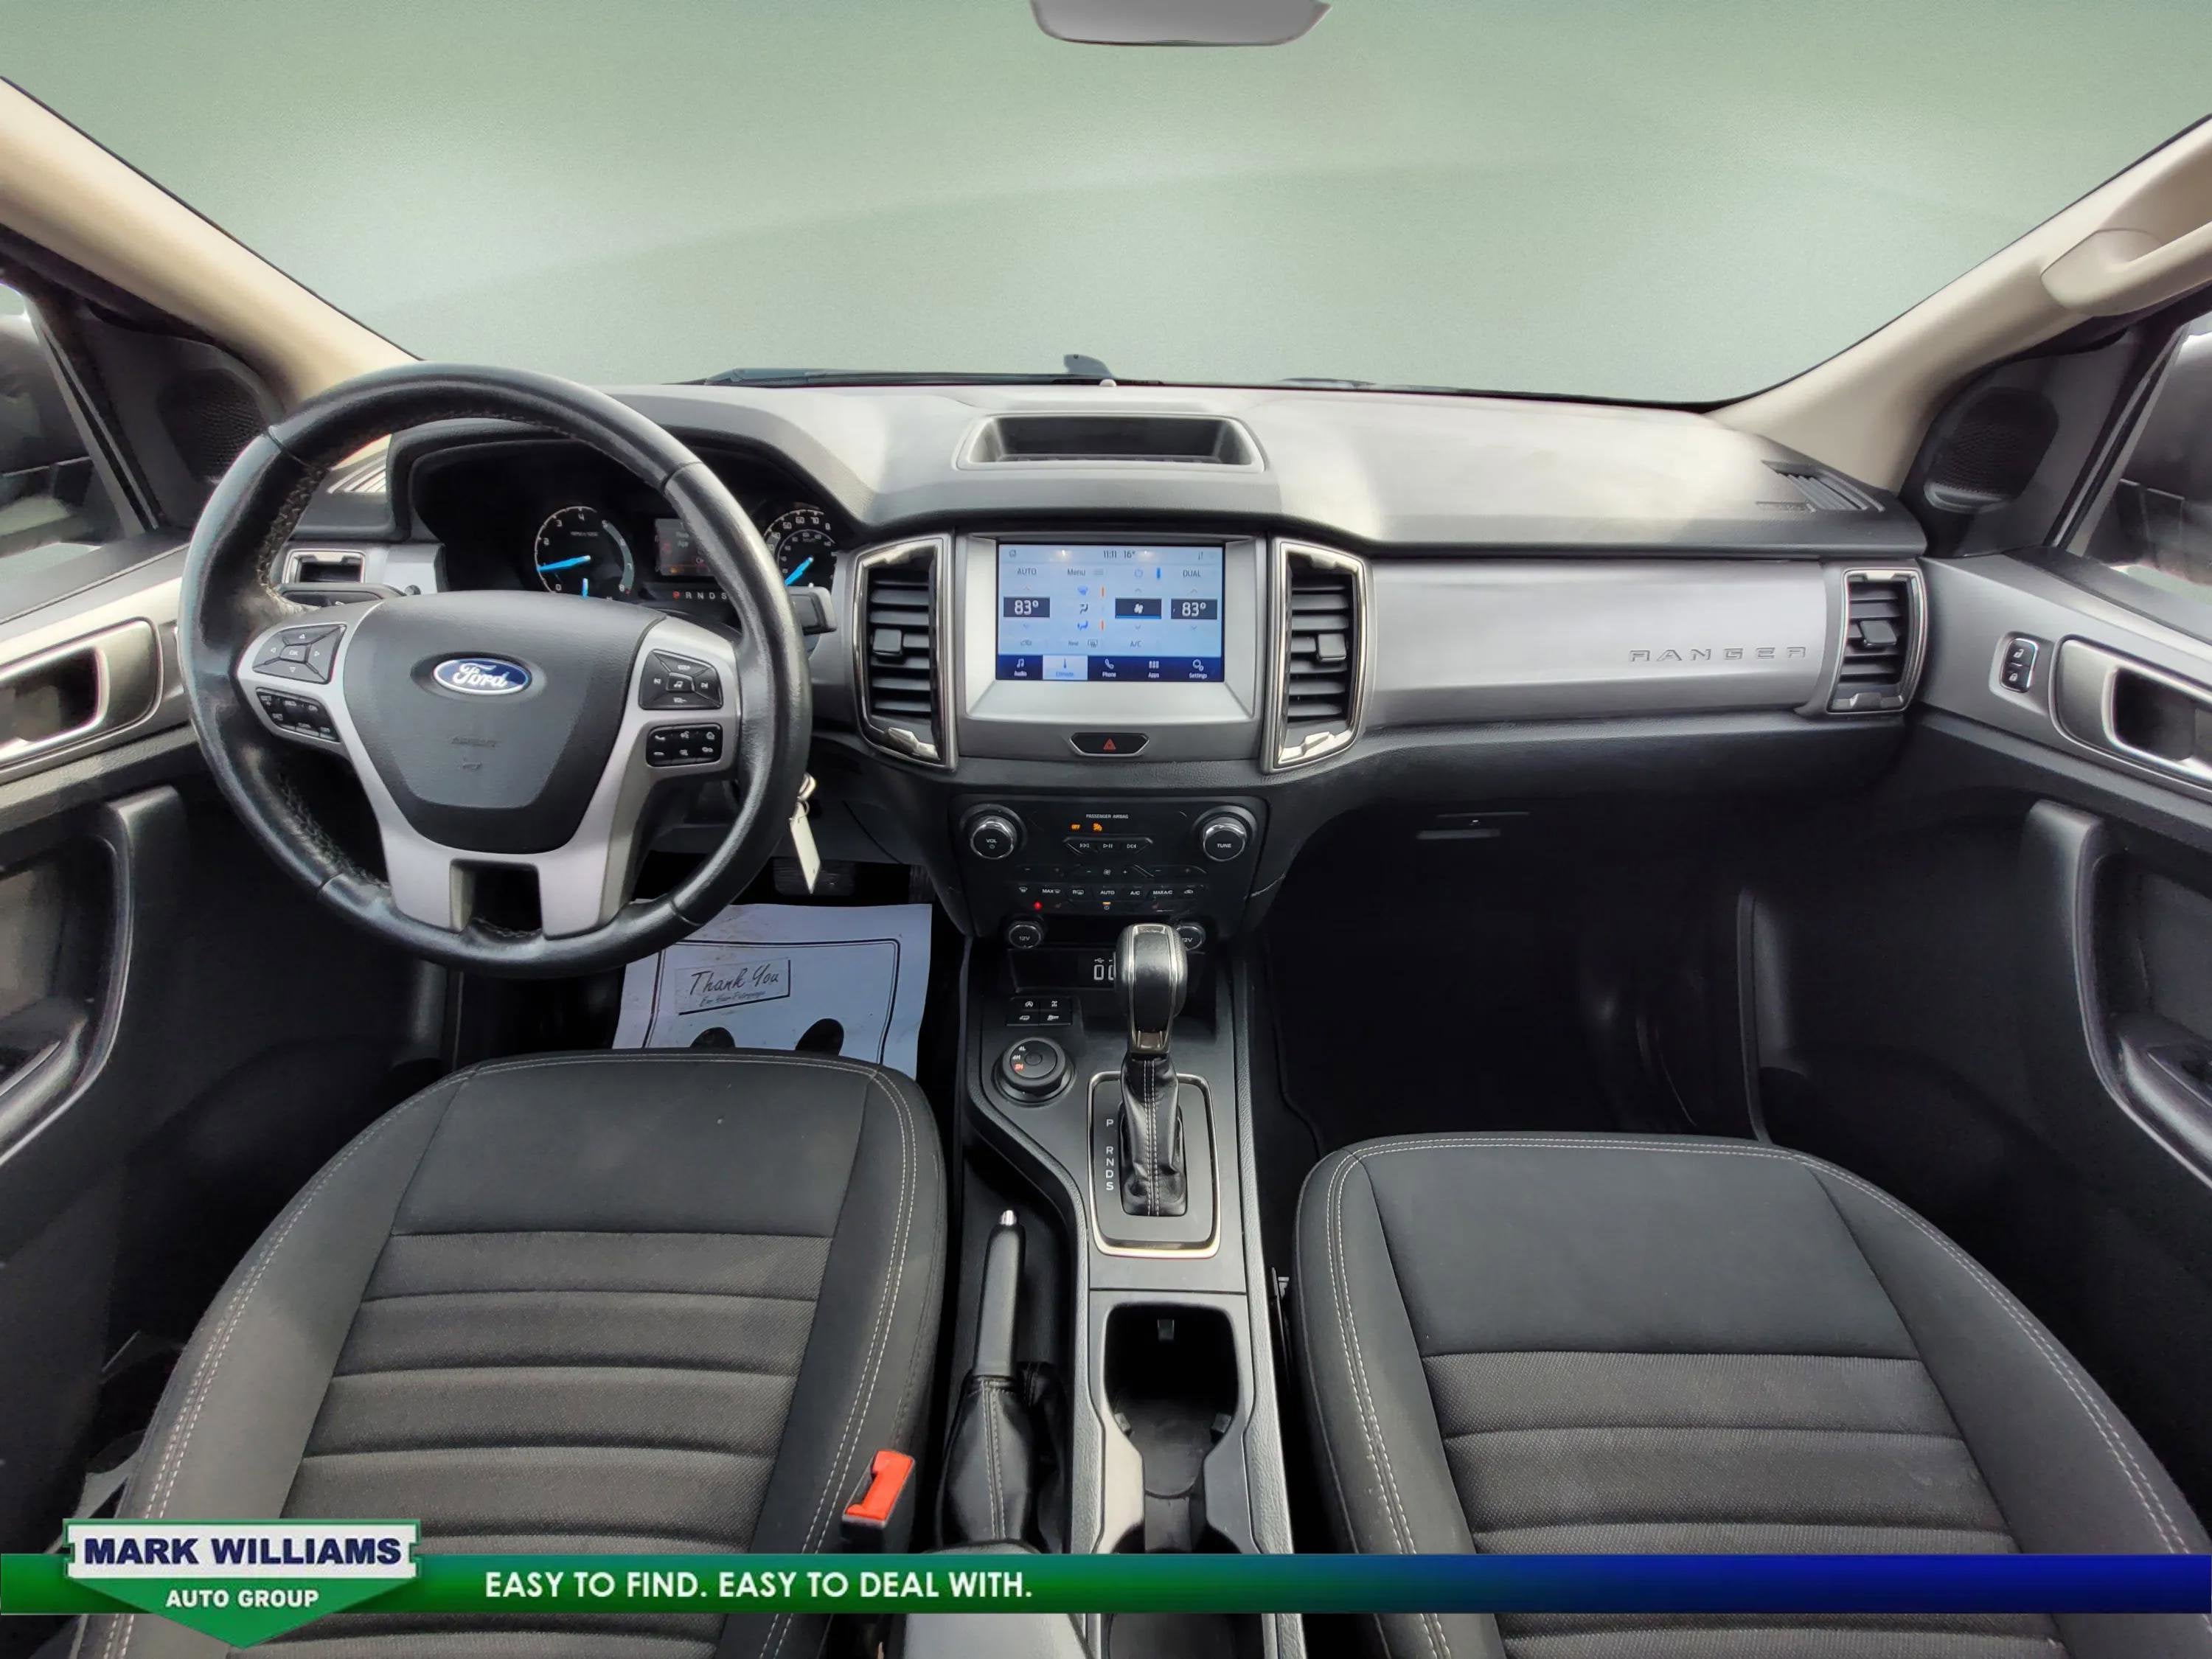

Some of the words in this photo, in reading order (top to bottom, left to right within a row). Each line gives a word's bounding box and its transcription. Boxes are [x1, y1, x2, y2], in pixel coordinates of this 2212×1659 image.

[1067, 568, 1086, 577] Menu
[1183, 570, 1201, 578] DUAL
[685, 591, 692, 599] R
[1629, 646, 1806, 662] RANGER
[453, 662, 510, 687] Ford
[689, 967, 748, 995] Thank
[752, 963, 779, 987] You
[1106, 1146, 1113, 1154] R
[1106, 1158, 1114, 1166] N
[1106, 1170, 1113, 1178] D
[1106, 1182, 1113, 1191] S
